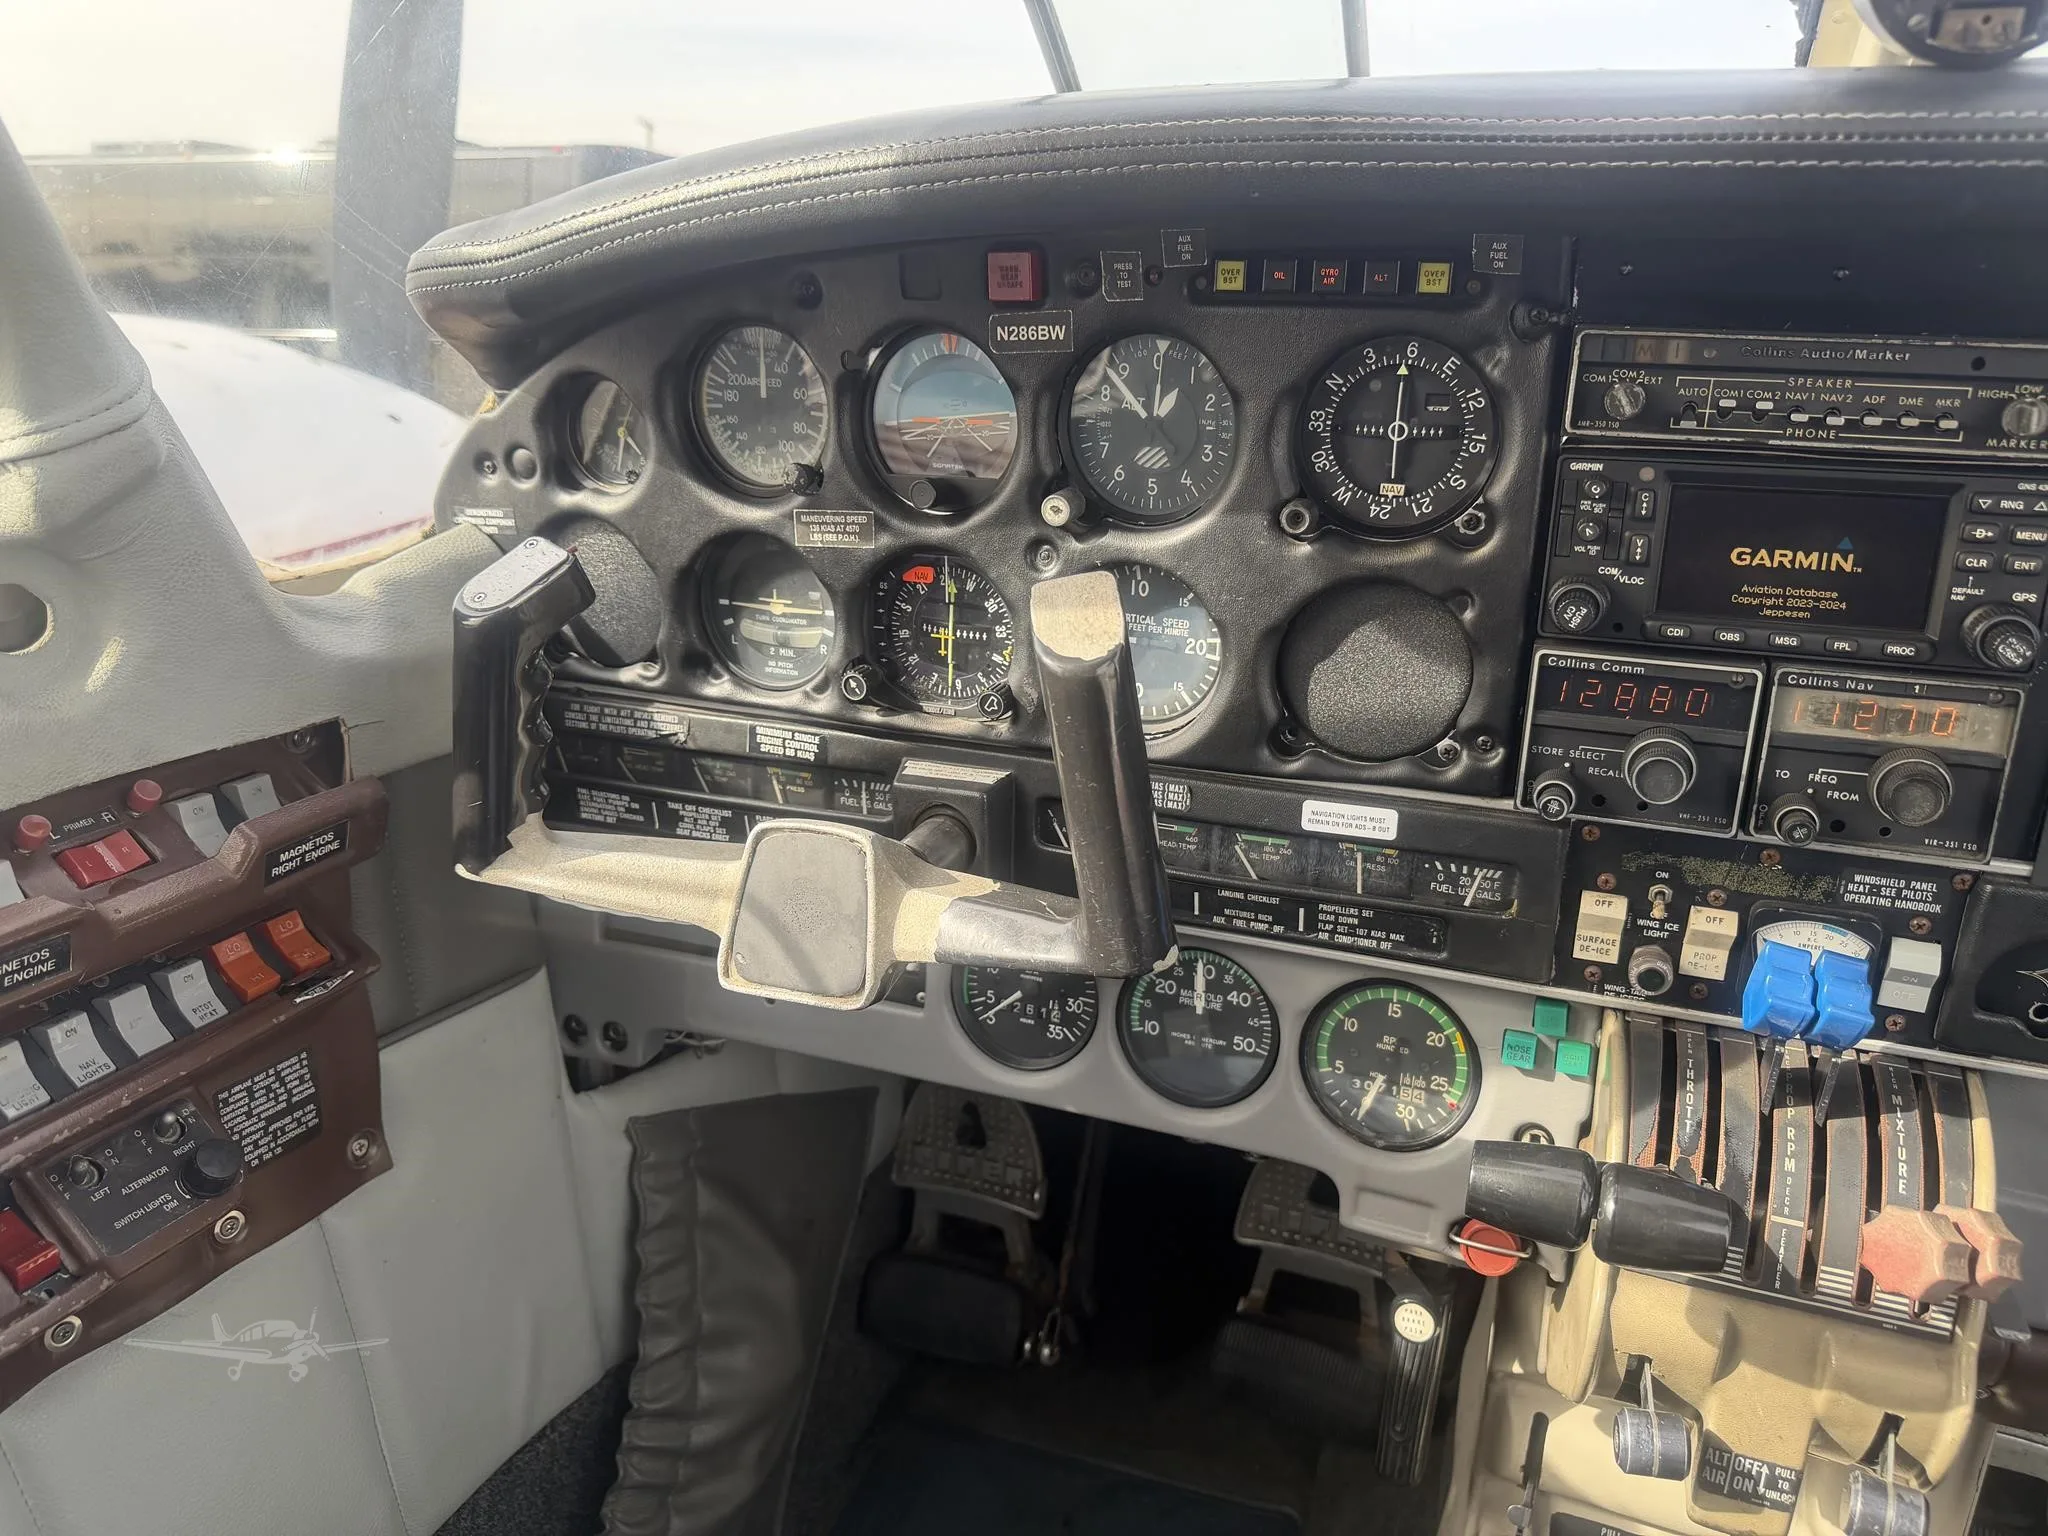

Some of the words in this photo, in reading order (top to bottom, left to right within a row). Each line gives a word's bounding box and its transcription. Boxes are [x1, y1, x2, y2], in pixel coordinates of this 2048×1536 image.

[1492, 242, 1507, 250] AUX
[1490, 251, 1508, 260] FUEL
[1220, 268, 1240, 276] OVER
[1274, 271, 1285, 280] OIL
[1320, 268, 1339, 276] GYRO
[1374, 273, 1388, 282] ALT
[1424, 269, 1445, 278] OVER
[1323, 276, 1336, 285] AIR
[1426, 278, 1442, 286] BST
[996, 325, 1066, 342] N286BW
[1741, 346, 1794, 358] Collins
[1800, 349, 1911, 361] Audio/Marker
[774, 363, 788, 374] 40
[1612, 370, 1637, 378] COM
[728, 374, 746, 386] 200
[1644, 377, 1663, 385] EXT
[1787, 377, 1853, 388] SPEAKER
[793, 388, 808, 400] 60
[1678, 388, 1708, 396] AUTO
[2015, 385, 2044, 393] LOW
[724, 390, 739, 402] 180
[1862, 395, 1886, 404] ADF
[1898, 397, 1924, 406] DME
[1935, 398, 1961, 408] MKR
[726, 416, 738, 424] 160
[793, 423, 807, 434] 80
[1786, 428, 1837, 439] PHONE
[736, 432, 748, 441] 140
[778, 440, 794, 451] 100
[1570, 462, 1604, 471] GARMIN
[1381, 485, 1404, 495] NAV
[2000, 500, 2024, 510] RNG
[1369, 504, 1391, 520] 24
[2016, 531, 2048, 541] MENU
[1730, 547, 1854, 573] GARMIN
[2014, 561, 2037, 570] ENT
[914, 571, 929, 581] NAV
[1131, 581, 1149, 597] 10
[1741, 584, 1783, 595] Aviation
[1785, 586, 1838, 599] Database
[1731, 594, 1784, 606] Copyright
[1786, 598, 1847, 610] 2023-2024
[2012, 592, 2037, 603] GPS
[1759, 608, 1810, 619] Jeppesen
[1162, 618, 1190, 629] SPEED
[1128, 623, 1146, 632] FEET
[1148, 624, 1162, 634] PER
[1164, 627, 1189, 637] MINUTE
[1719, 632, 1740, 642] OBS
[1775, 636, 1797, 646] MSG
[1184, 640, 1207, 656] 20
[1834, 641, 1851, 651] FPL
[1887, 646, 1915, 656] PROC
[1548, 656, 1596, 670] Collins
[1601, 661, 1645, 675] Comm
[1787, 674, 1839, 688] Collins
[1846, 680, 1874, 691] Nav
[756, 735, 784, 746] ENGINE
[785, 740, 819, 752] CONTROL
[1531, 745, 1563, 756] STORE
[1568, 750, 1606, 761] SELECT
[1775, 769, 1790, 779] TO
[1808, 773, 1837, 785] FREQ
[1826, 790, 1859, 801] FROM
[840, 797, 859, 807] FUEL
[874, 801, 893, 810] GALS
[1311, 810, 1345, 820] NAVIGATION
[1346, 814, 1368, 822] LIGHTS
[63, 817, 96, 832] PRIMER
[280, 832, 335, 862] MAGNETOS
[271, 856, 302, 877] RIGHT
[305, 840, 341, 862] ENGINE
[1655, 871, 1669, 879] ON
[1854, 874, 1906, 888] WINDSHIELD
[1910, 881, 1938, 892] PANEL
[1217, 889, 1245, 900] LANDING
[1247, 894, 1280, 904] CHECKLIST
[1430, 882, 1455, 894] FUEL
[1476, 890, 1501, 901] GALS
[1847, 883, 1870, 894] HEAT
[1880, 888, 1897, 897] SEE
[1902, 890, 1933, 901] PILOTS
[1594, 900, 1614, 908] OFF
[1844, 893, 1891, 908] OPERATING
[1894, 899, 1942, 913] HANDBOOK
[1224, 908, 1255, 919] MIXTURES
[1257, 913, 1272, 922] RICH
[1318, 904, 1359, 915] PROPELLERS
[1361, 909, 1374, 918] SET
[1318, 913, 1335, 921] GEAR
[1338, 915, 1359, 925] DOWN
[1637, 918, 1660, 928] WING
[1664, 922, 1680, 931] ICE
[1705, 916, 1724, 925] OFF
[279, 920, 293, 932] LO
[1232, 919, 1247, 928] FUEL
[1250, 921, 1269, 931] PUMP
[1272, 925, 1285, 934] OFF
[1643, 928, 1669, 939] LIGHT
[1576, 934, 1617, 947] SURFACE
[1579, 945, 1611, 956] DE-ICE
[3, 960, 56, 988] ENGINE
[986, 990, 995, 1003] 5
[192, 1000, 214, 1016] PITOT
[199, 1009, 219, 1023] HEAT
[1144, 1020, 1160, 1035] 10
[1247, 1018, 1259, 1027] 45
[1344, 1017, 1358, 1032] 10
[1047, 1024, 1063, 1040] 35
[1233, 1036, 1255, 1052] 50
[1426, 1031, 1445, 1047] 20
[1506, 1044, 1531, 1054] NOSE
[1506, 1052, 1531, 1063] GEAR
[77, 1062, 111, 1083] LIGHTS
[1430, 1075, 1448, 1091] 25
[1786, 1073, 1794, 1119] PROP
[1395, 1103, 1415, 1119] 30
[173, 1140, 196, 1157] RIGHT
[1784, 1127, 1795, 1172] RPM
[1892, 1094, 1908, 1195] MIXTURE
[121, 1165, 169, 1196] ALTERNATOR
[90, 1186, 111, 1202] LEFT
[1784, 1176, 1792, 1215] DECR
[114, 1204, 145, 1230] SWITCH
[144, 1193, 172, 1212] LIGHTS
[163, 1200, 180, 1212] DIM
[1775, 1228, 1787, 1289] FEATHER
[1705, 1447, 1731, 1466] ALT
[1734, 1456, 1762, 1476] OFF
[1702, 1466, 1726, 1485] AIR
[1733, 1476, 1754, 1493] ON
[1775, 1467, 1796, 1480] PULL
[1778, 1480, 1789, 1490] TO
